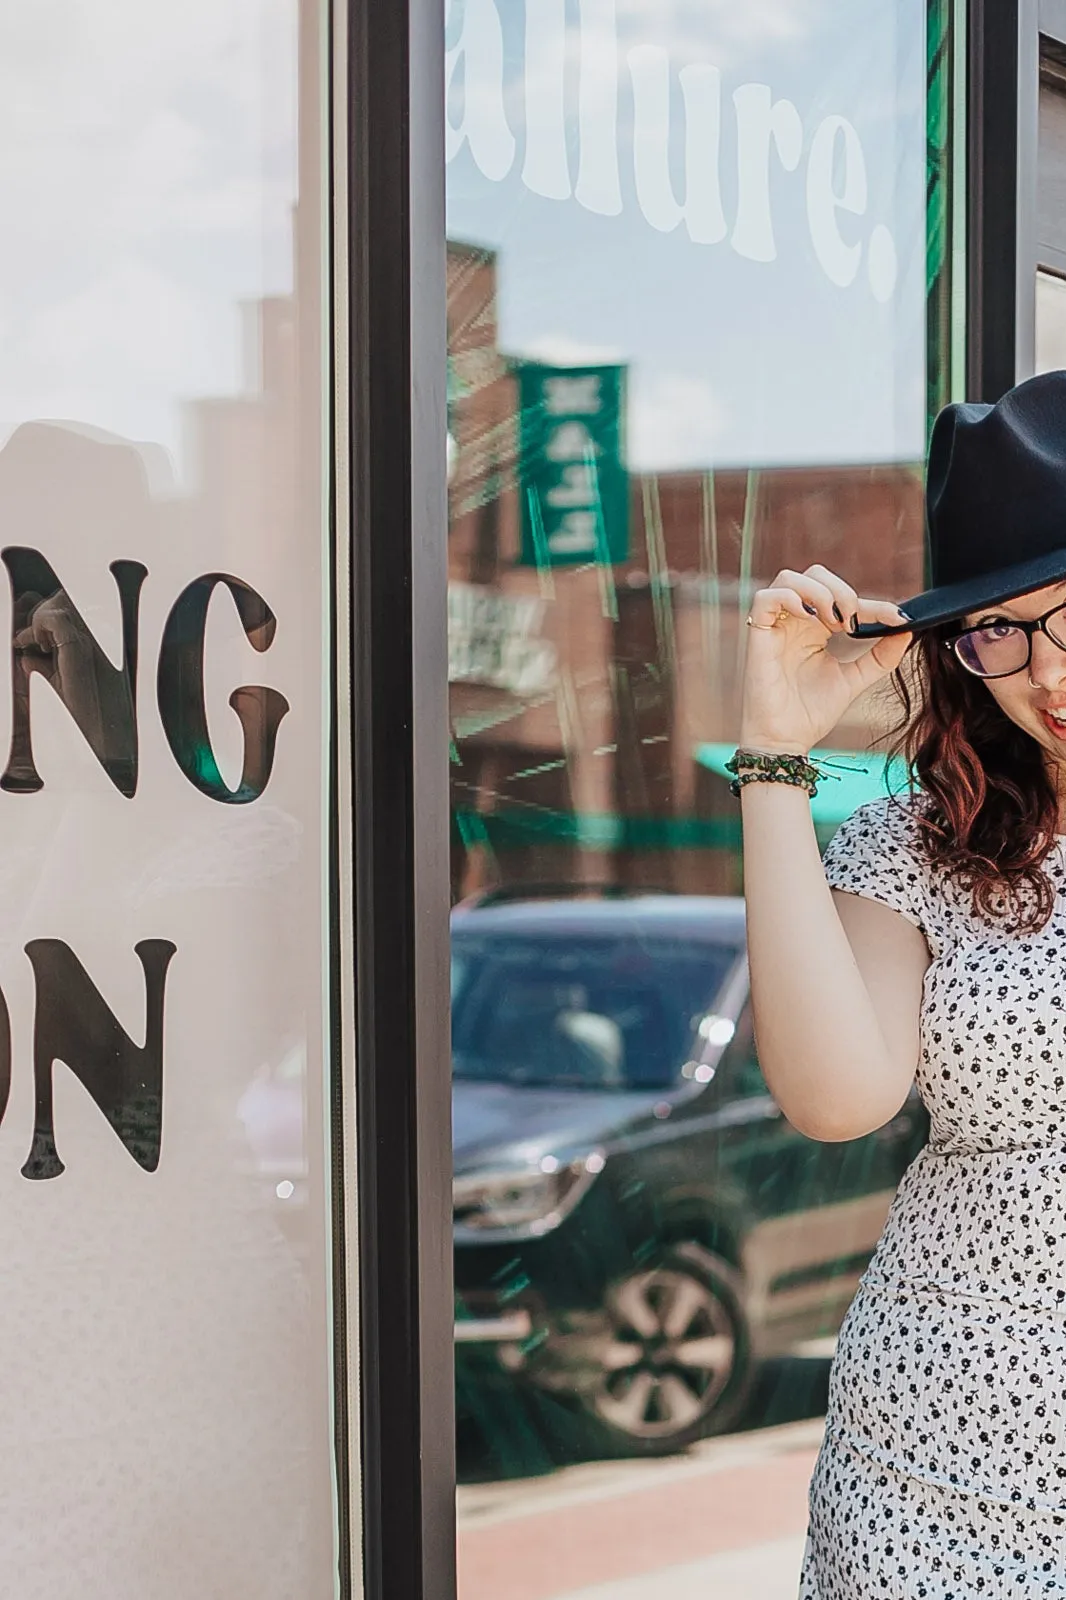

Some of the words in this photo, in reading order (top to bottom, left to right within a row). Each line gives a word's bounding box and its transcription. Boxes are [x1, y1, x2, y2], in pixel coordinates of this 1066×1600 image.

[445, 0, 897, 303] allure.
[0, 546, 290, 804] NG
[0, 938, 177, 1180] N
